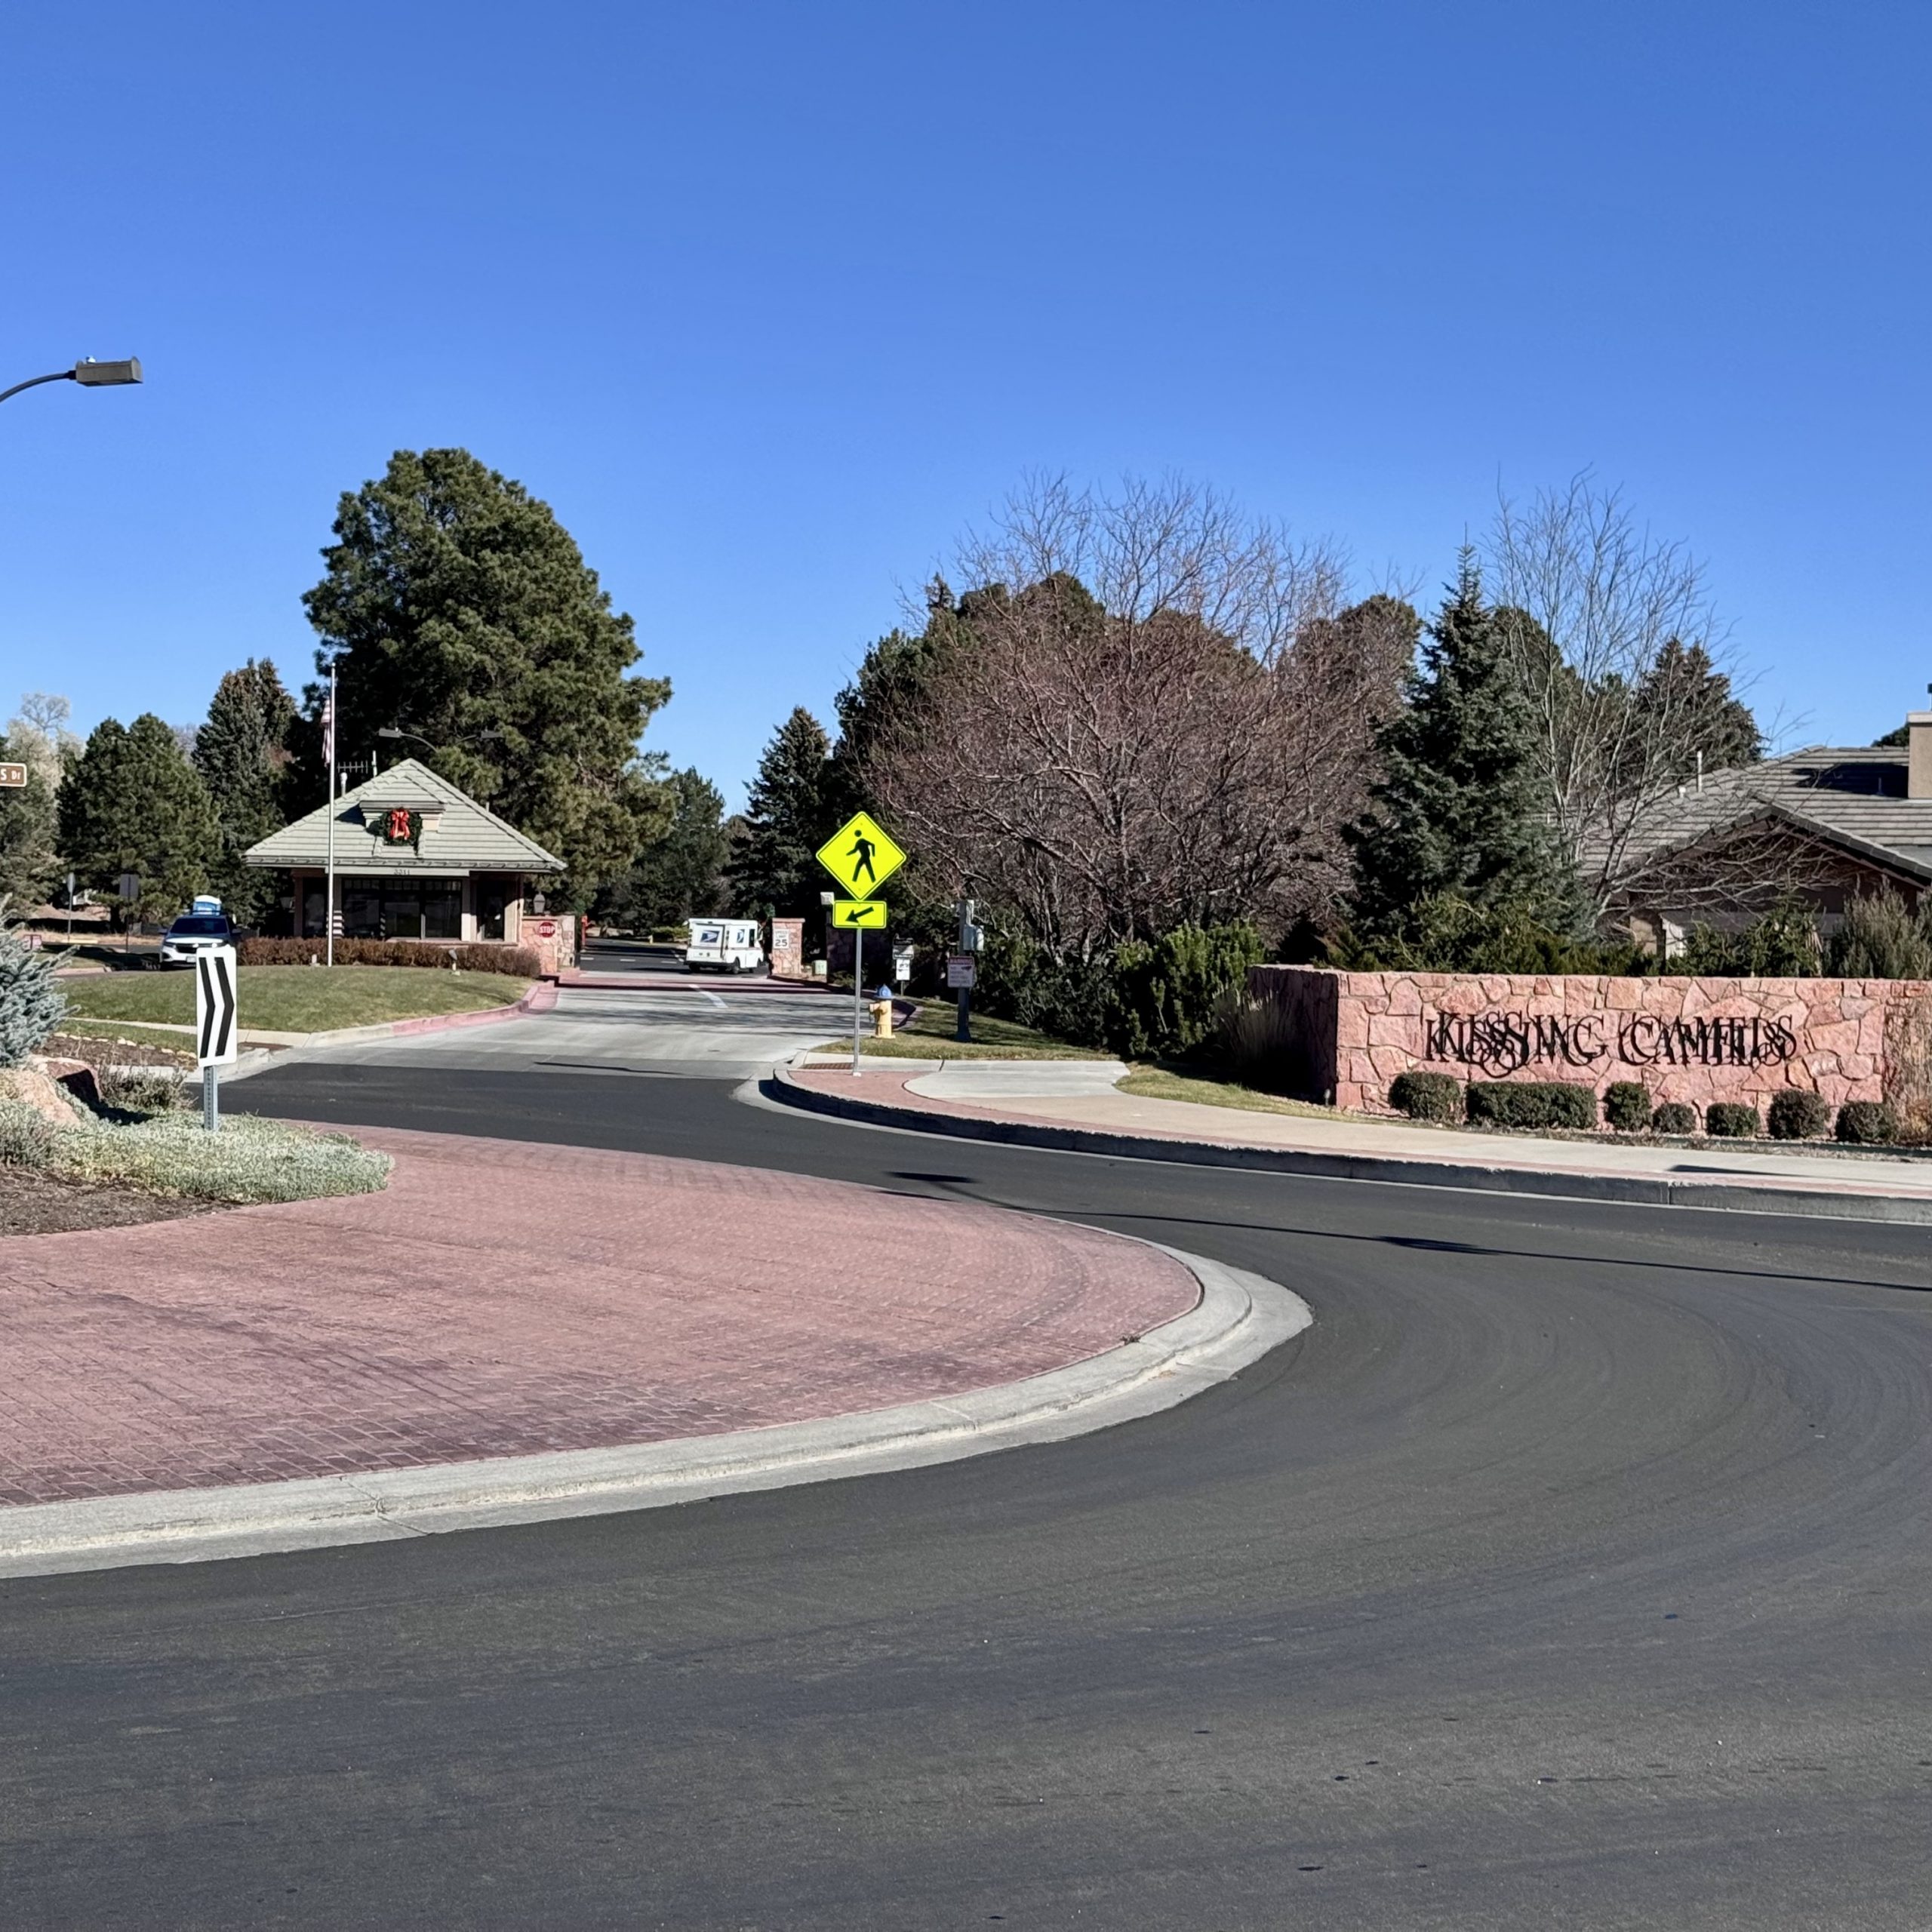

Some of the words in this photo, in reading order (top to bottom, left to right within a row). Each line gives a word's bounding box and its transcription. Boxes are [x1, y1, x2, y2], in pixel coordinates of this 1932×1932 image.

[11, 771, 21, 780] Dr
[540, 925, 555, 934] STOP
[1422, 1011, 1608, 1078] KISSING
[1618, 1014, 1796, 1066] CAMELS
